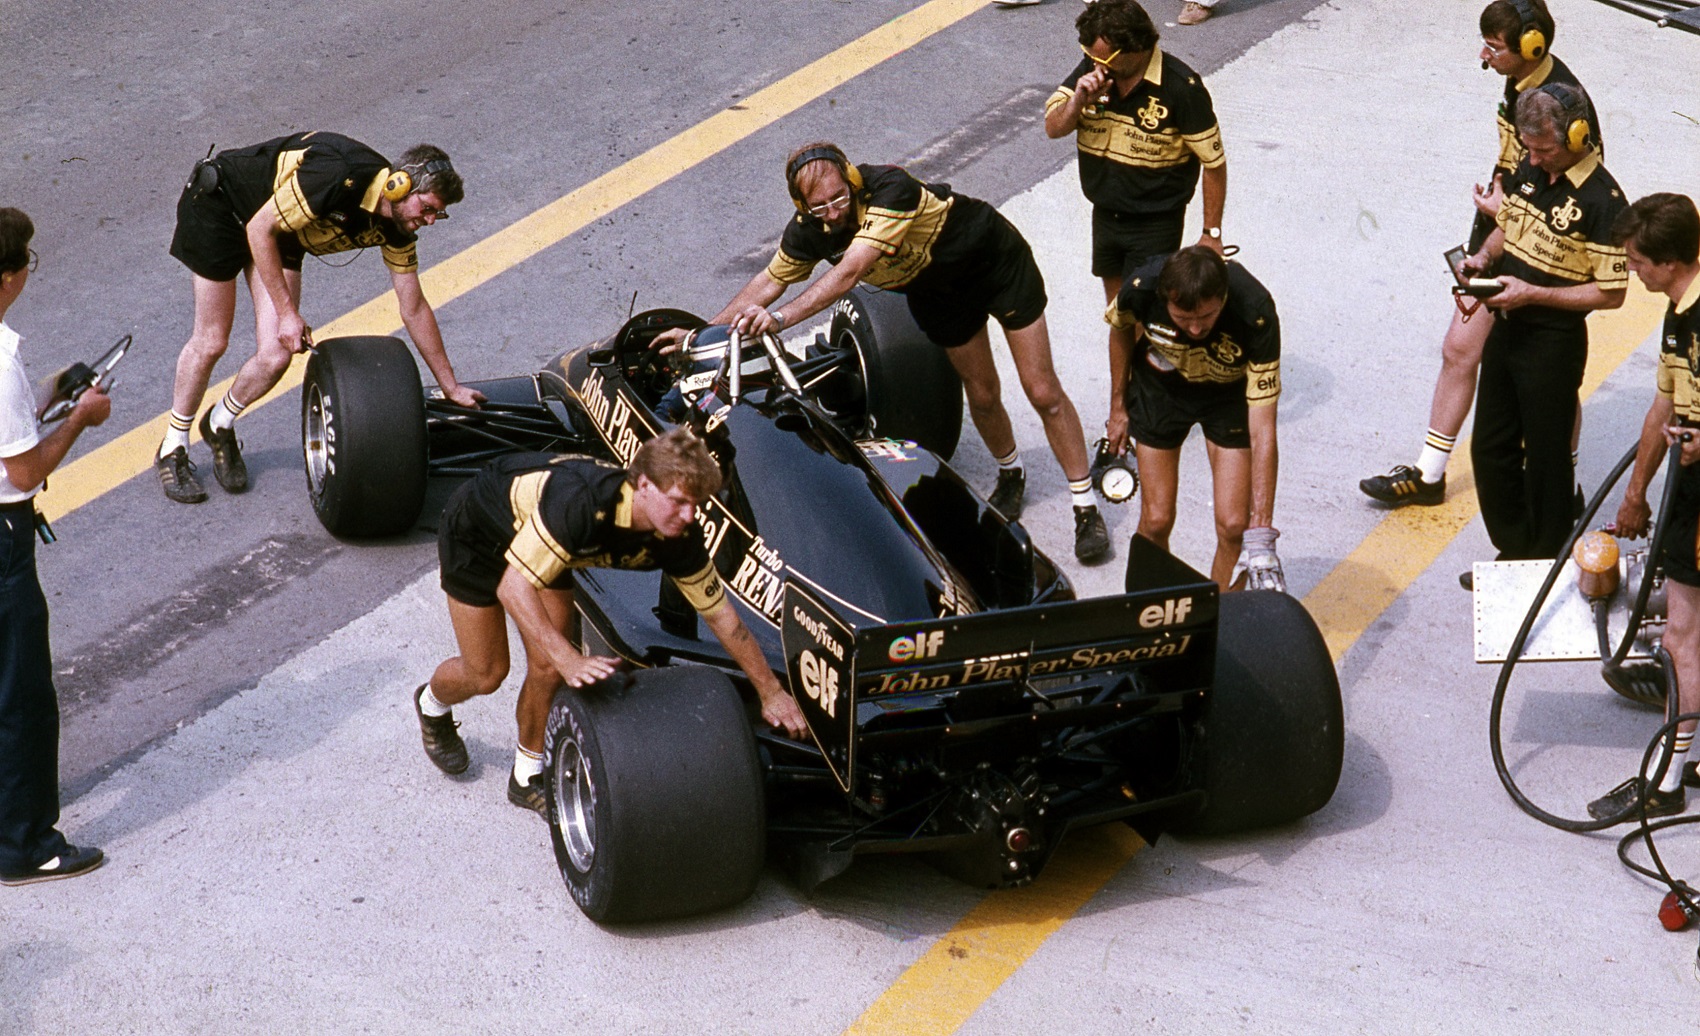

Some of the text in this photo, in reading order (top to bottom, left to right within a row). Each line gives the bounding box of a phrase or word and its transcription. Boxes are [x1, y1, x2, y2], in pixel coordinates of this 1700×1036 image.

[1124, 129, 1144, 142] John
[1130, 143, 1161, 155] Special
[860, 219, 874, 232] lf
[1532, 226, 1577, 254] John Player
[1532, 242, 1566, 263] Special
[1612, 262, 1627, 273] el
[1257, 376, 1277, 391] elf
[581, 367, 644, 470] John Play
[749, 535, 784, 573] Turbo
[705, 575, 721, 598] elf
[1139, 597, 1193, 629] elf
[793, 605, 844, 662] GOODYEAR
[888, 630, 945, 663] elf
[868, 671, 951, 695] John
[1068, 634, 1192, 670] Special
[800, 649, 839, 719] elf
